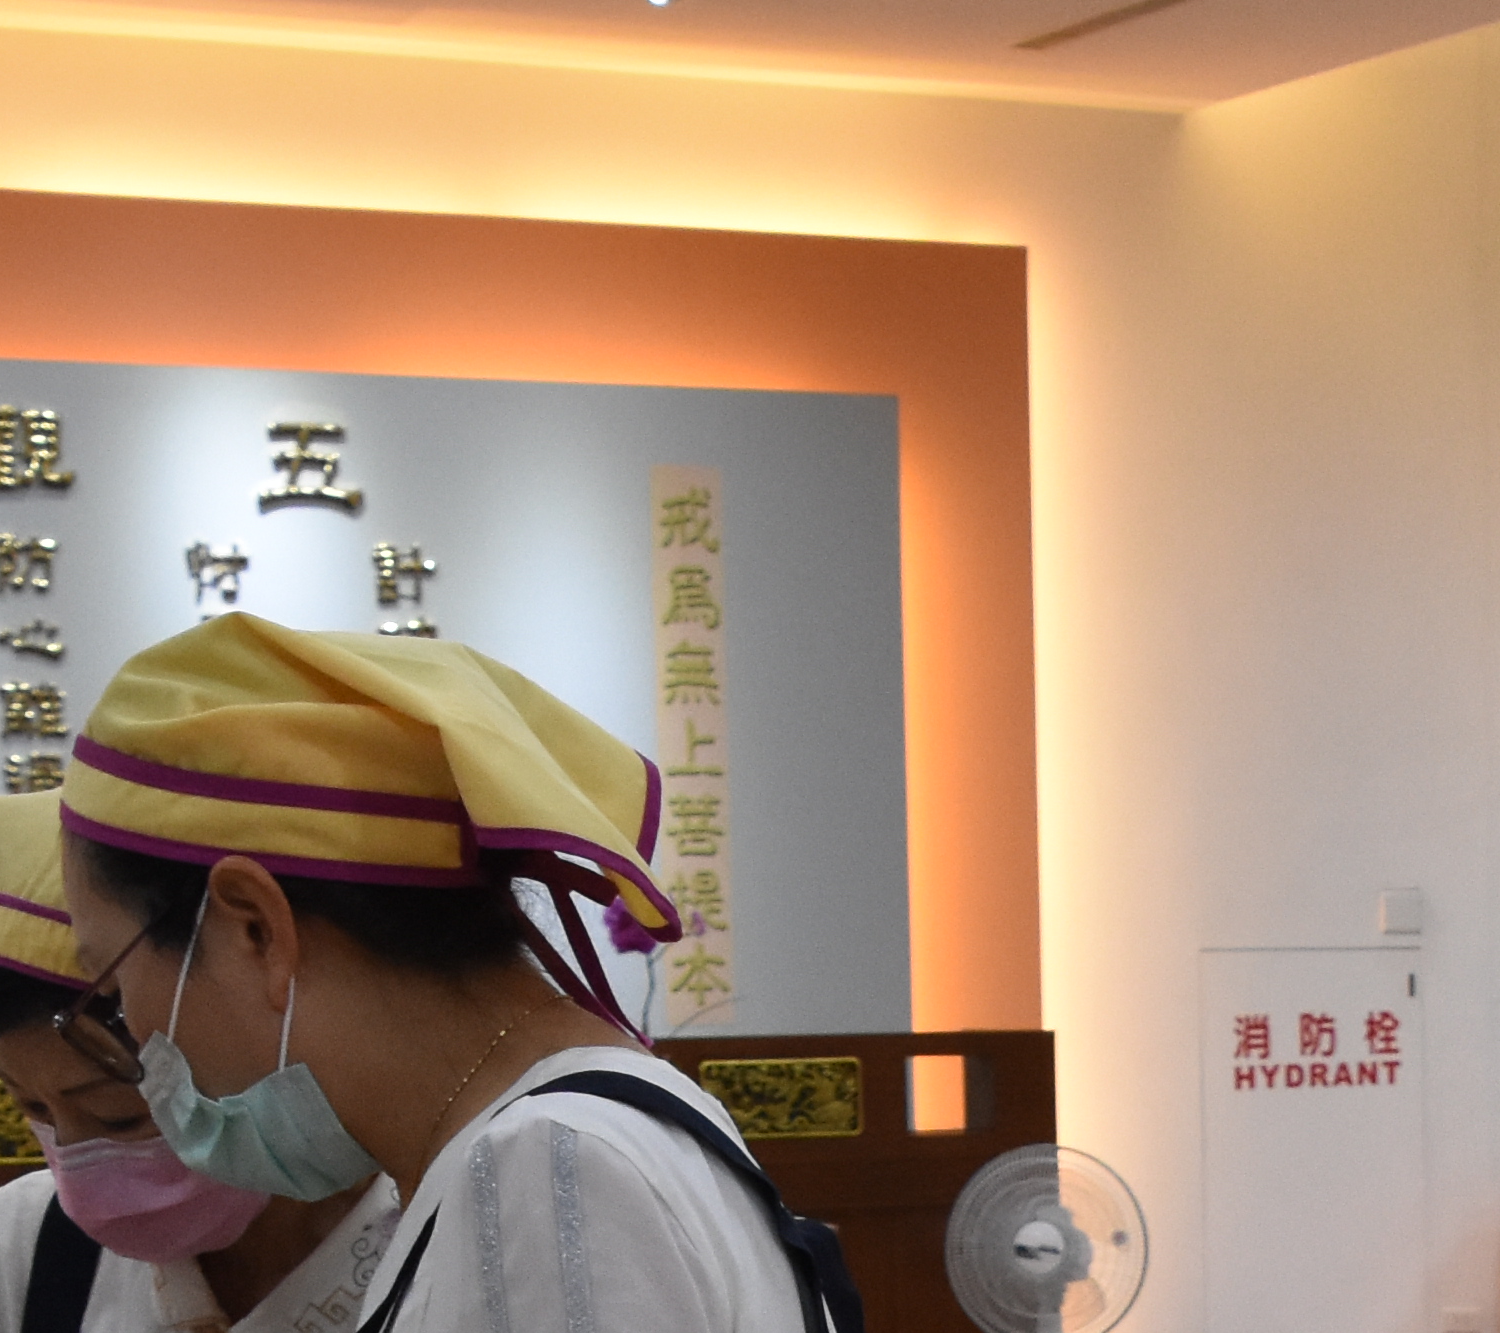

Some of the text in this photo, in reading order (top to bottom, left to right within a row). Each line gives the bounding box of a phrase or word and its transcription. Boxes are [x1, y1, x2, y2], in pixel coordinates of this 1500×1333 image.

[1233, 1010, 1401, 1060] 消防栓
[1233, 1061, 1401, 1090] HYDRANT
